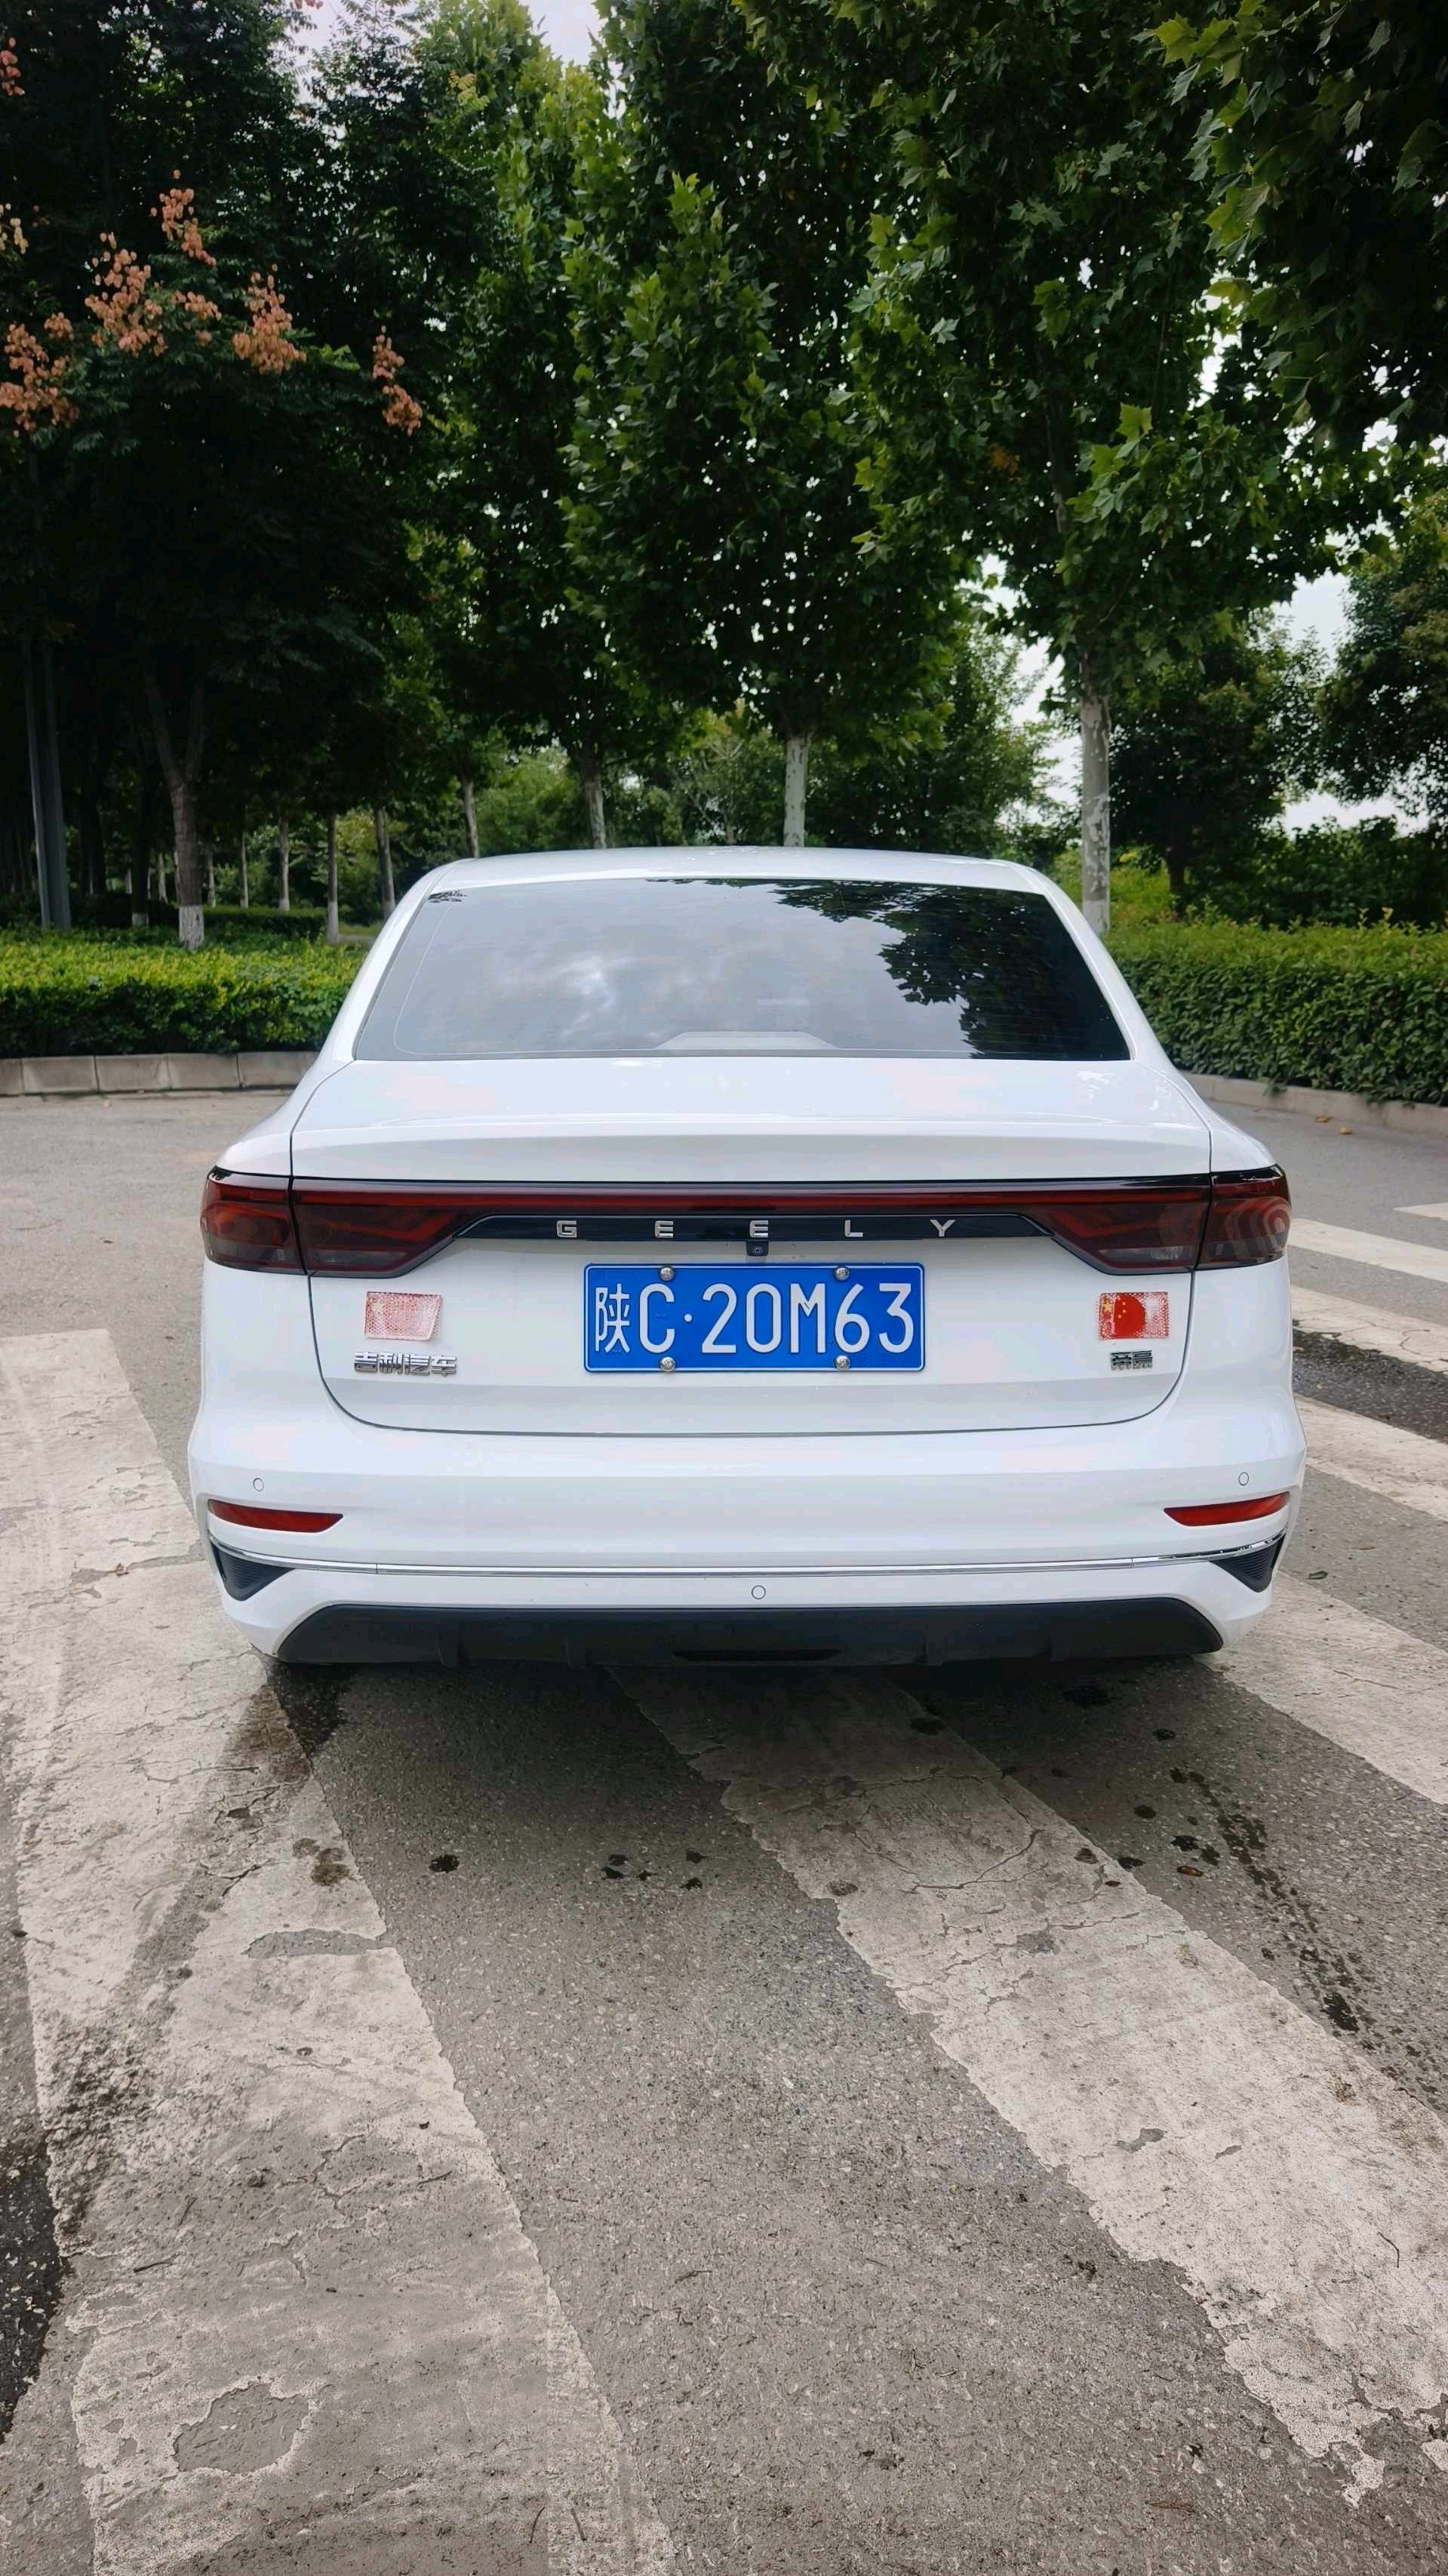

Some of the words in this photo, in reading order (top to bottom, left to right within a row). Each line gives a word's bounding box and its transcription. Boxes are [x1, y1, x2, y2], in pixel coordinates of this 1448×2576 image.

[556, 1220, 955, 1238] GEELY
[354, 1352, 457, 1376] 吉利汽车
